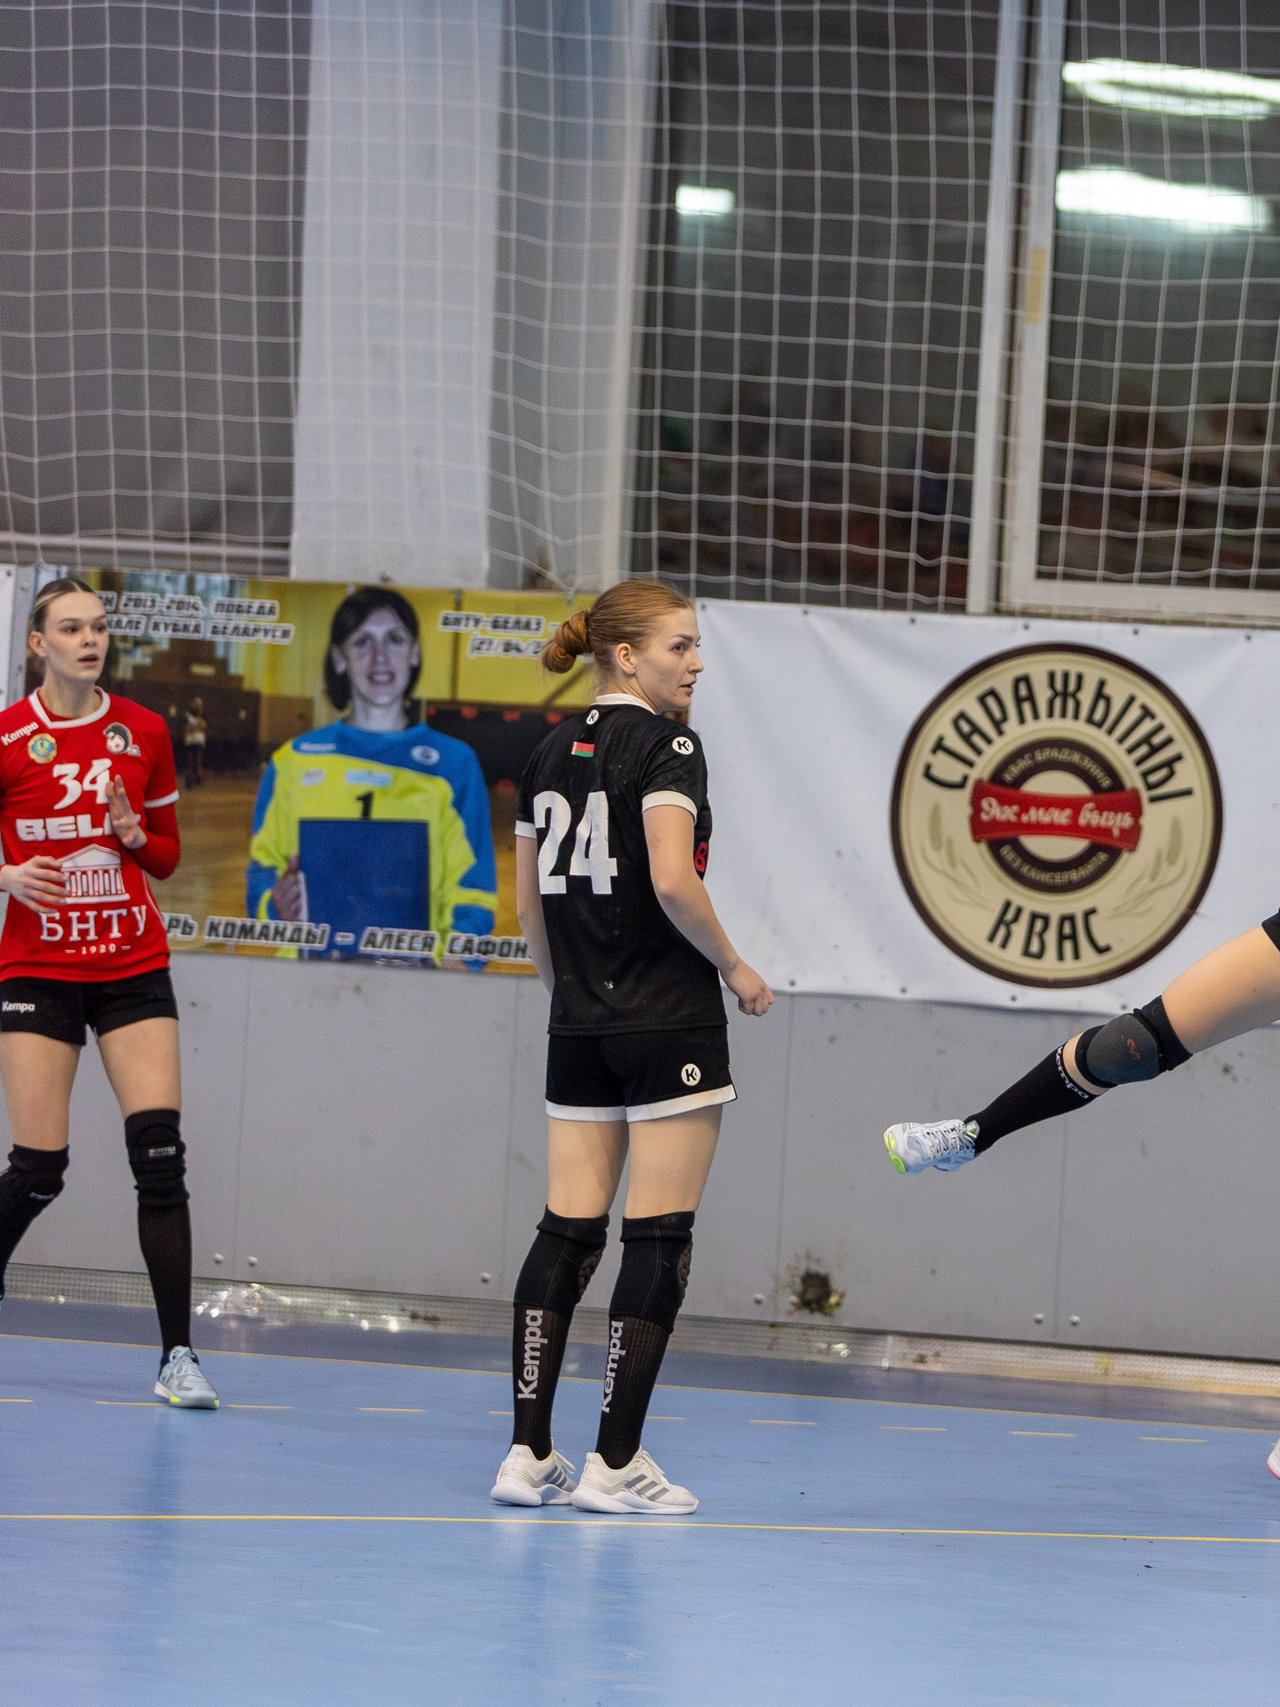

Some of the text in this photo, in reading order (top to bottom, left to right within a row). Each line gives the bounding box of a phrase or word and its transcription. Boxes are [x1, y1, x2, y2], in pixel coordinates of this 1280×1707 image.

[151, 621, 202, 634] КУБКА
[210, 624, 292, 640] БЕЛАРУСИ
[1, 721, 39, 746] Kempa
[922, 669, 1194, 803] СТАРАЖЫТНЫ
[53, 758, 112, 810] 34
[16, 811, 141, 842] BEL
[533, 790, 619, 894] 24
[40, 905, 147, 941] БНТУ
[167, 917, 327, 945] РЬ КОМАНДЫ
[986, 899, 1113, 961] КВАС
[362, 931, 534, 959] АЛЕСЯ САФОН
[2, 1001, 35, 1014] Kempa
[517, 1309, 548, 1399] Kempa
[601, 1320, 626, 1413] Kempa
